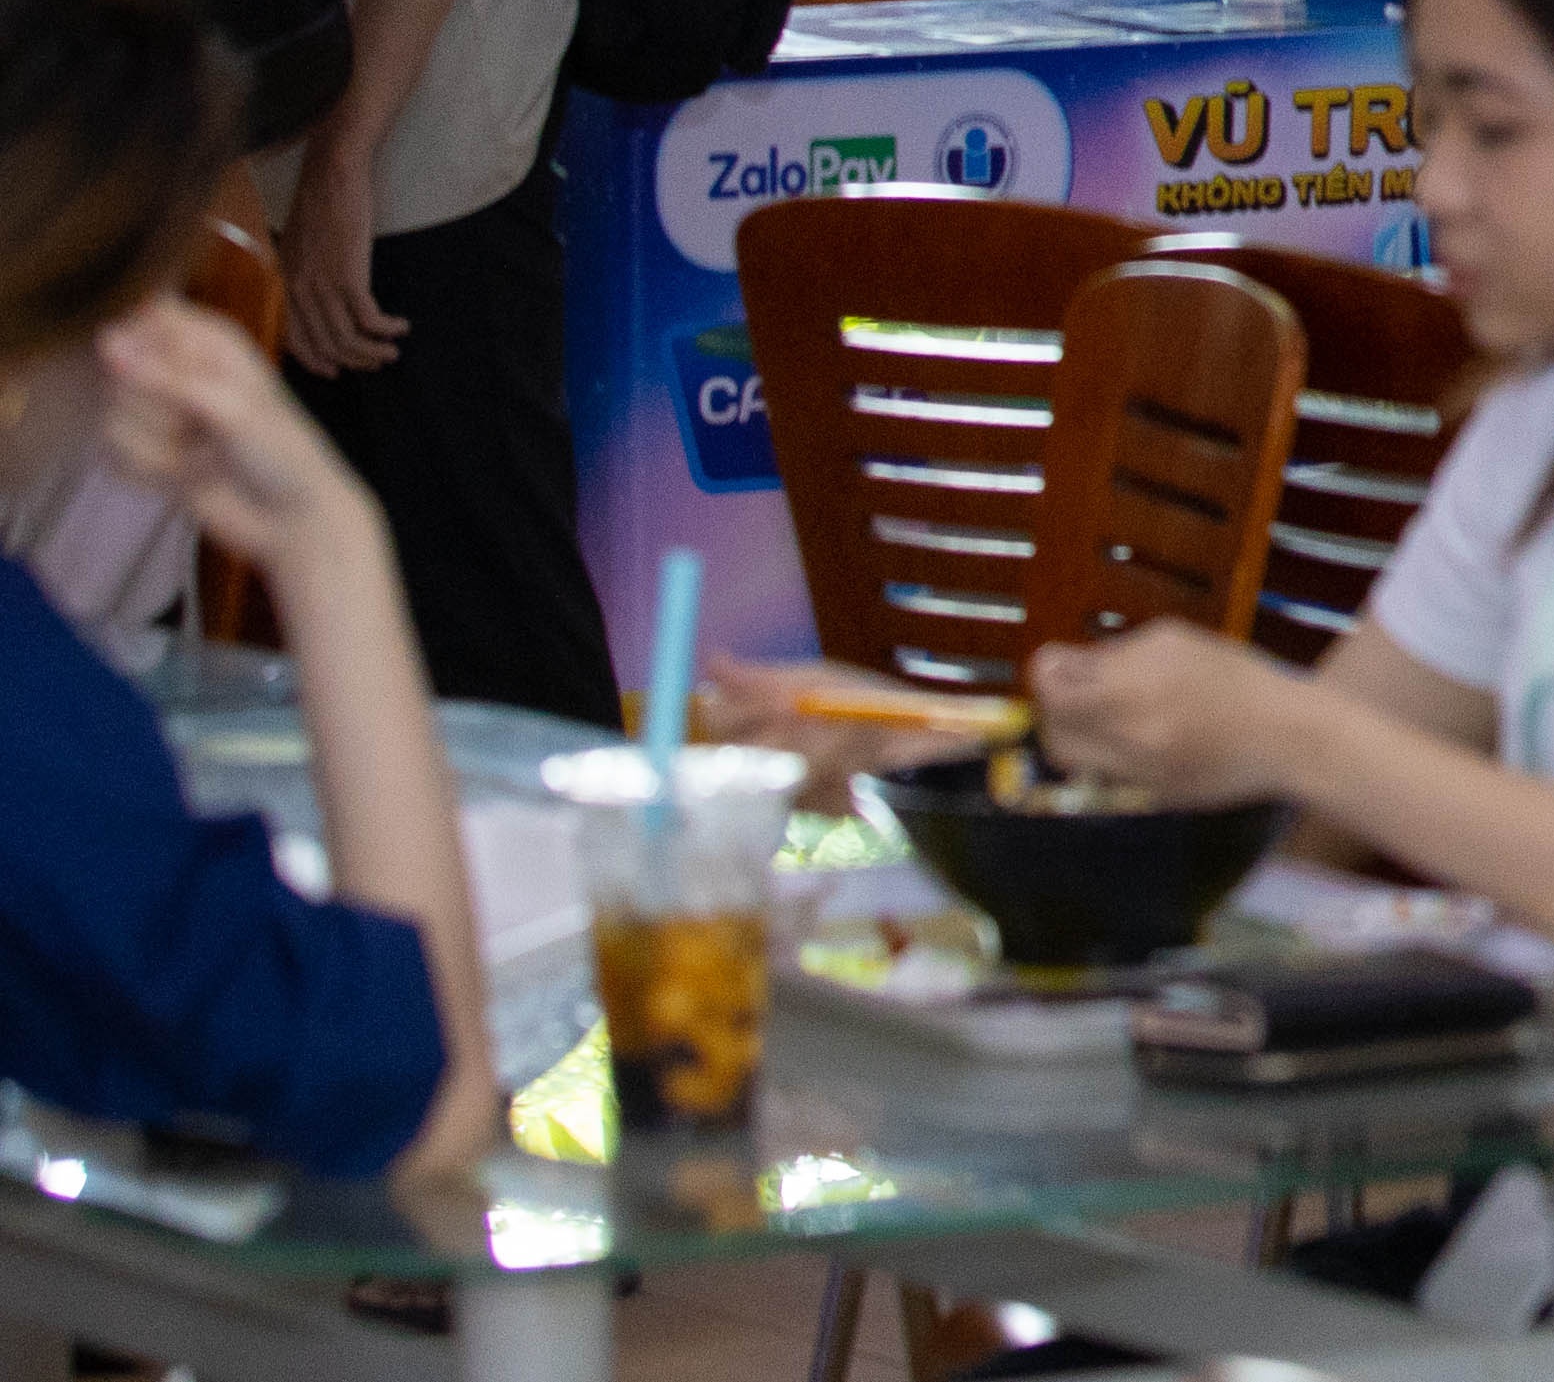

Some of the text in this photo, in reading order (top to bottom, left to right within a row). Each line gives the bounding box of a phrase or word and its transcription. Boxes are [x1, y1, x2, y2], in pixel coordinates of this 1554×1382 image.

[1143, 79, 1411, 170] VŨ TR
[1157, 174, 1286, 216] KHÔNG
